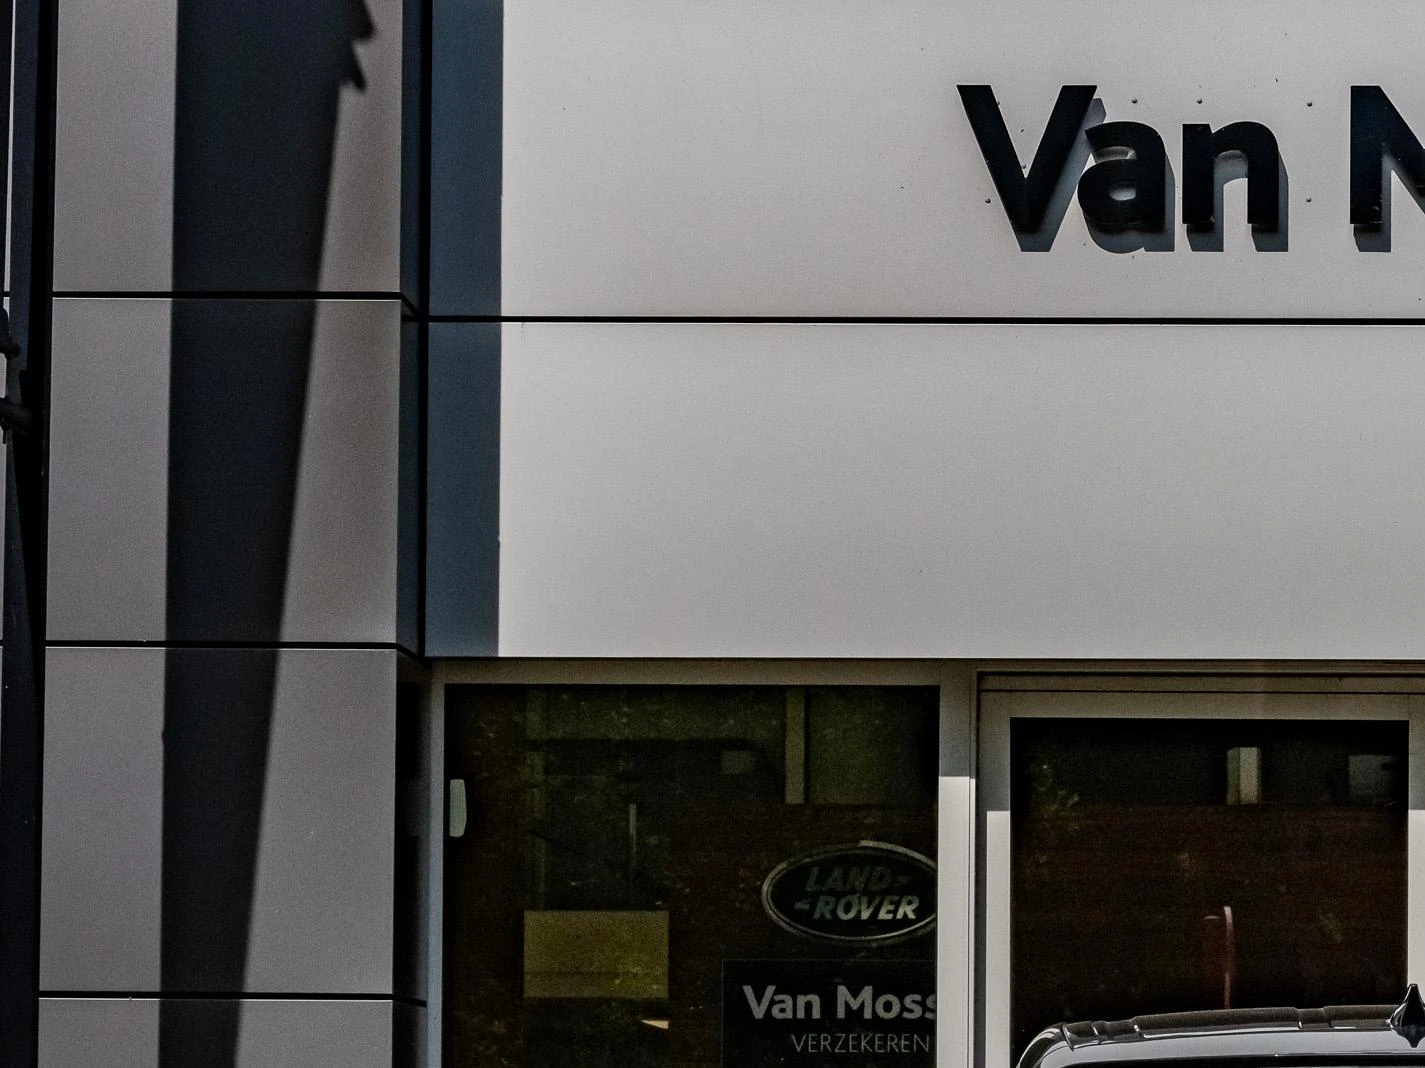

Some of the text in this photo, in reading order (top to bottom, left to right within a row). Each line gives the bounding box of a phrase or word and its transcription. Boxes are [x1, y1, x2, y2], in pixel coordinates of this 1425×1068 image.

[955, 83, 1281, 232] Van
[805, 866, 893, 893] LAND
[811, 894, 921, 921] ROVER
[742, 984, 821, 1020] Van
[791, 1033, 929, 1053] VERZEKEREN
